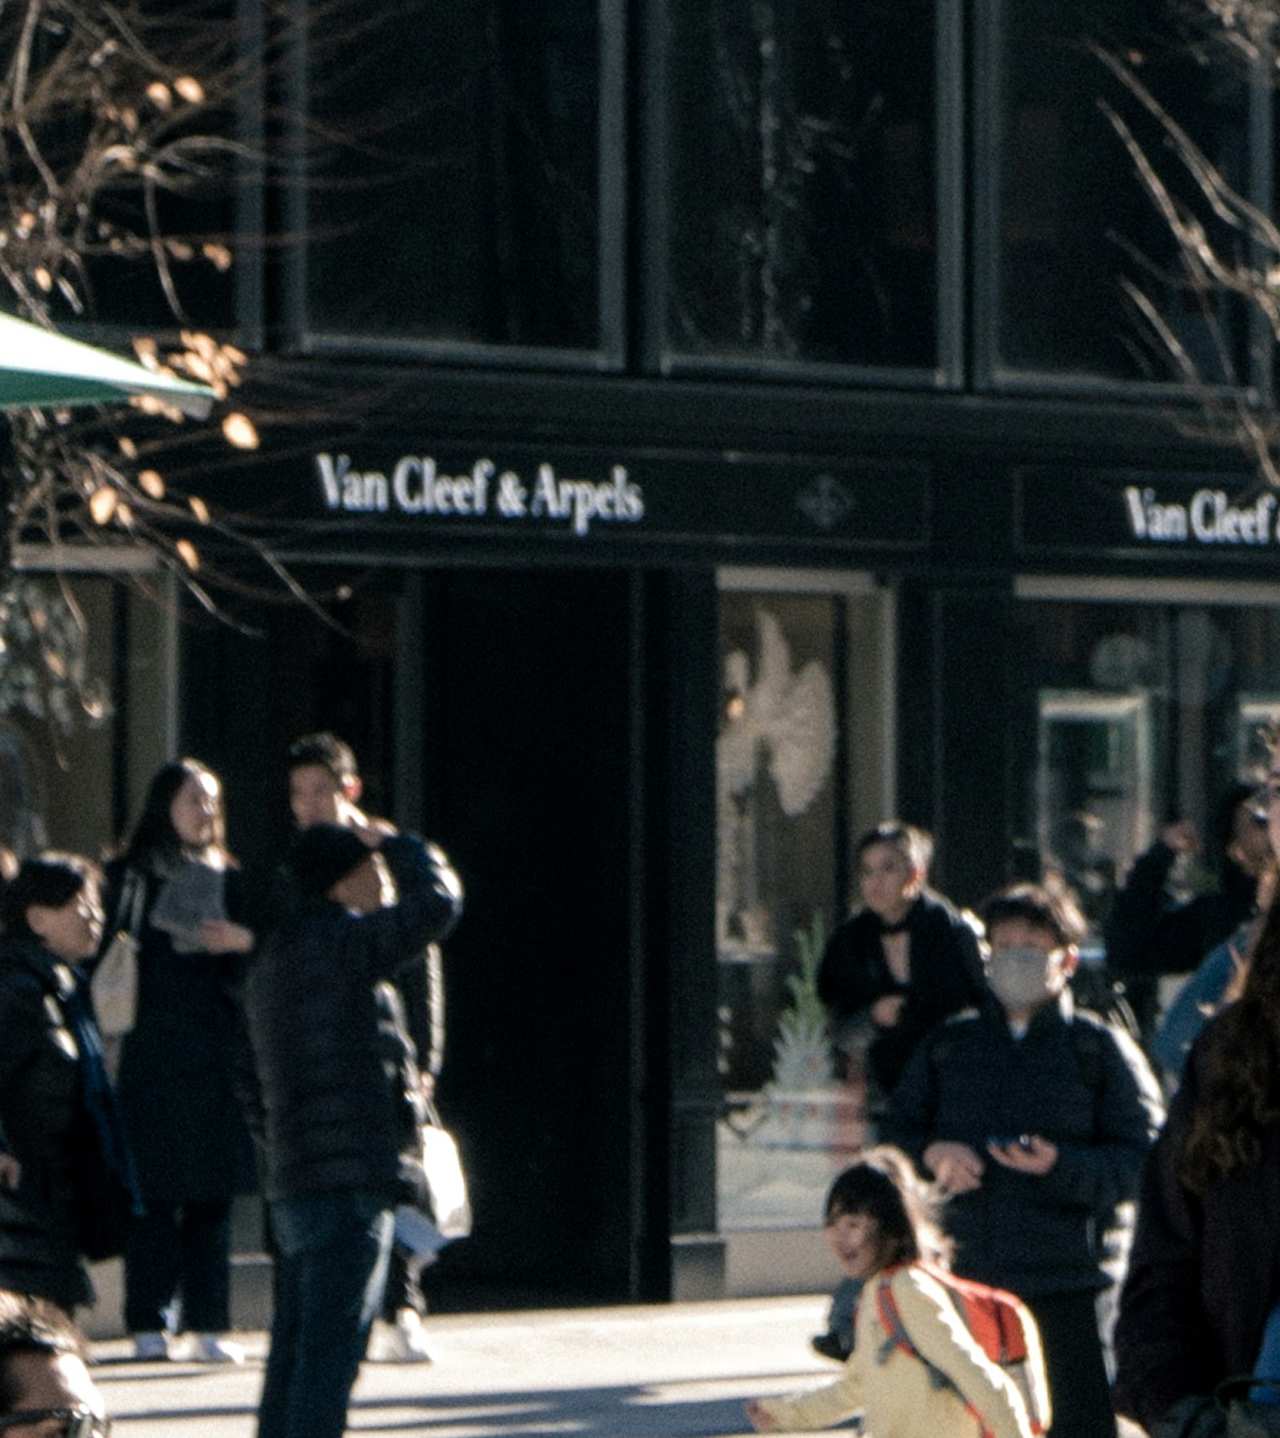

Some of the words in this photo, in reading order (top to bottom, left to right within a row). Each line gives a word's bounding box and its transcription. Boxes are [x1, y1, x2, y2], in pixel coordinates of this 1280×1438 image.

[317, 452, 389, 511] Van
[392, 455, 495, 515] Cleef
[497, 471, 527, 518] &
[530, 461, 644, 536] Arpels
[1125, 486, 1189, 541] Van
[1190, 488, 1276, 546] Cleef
